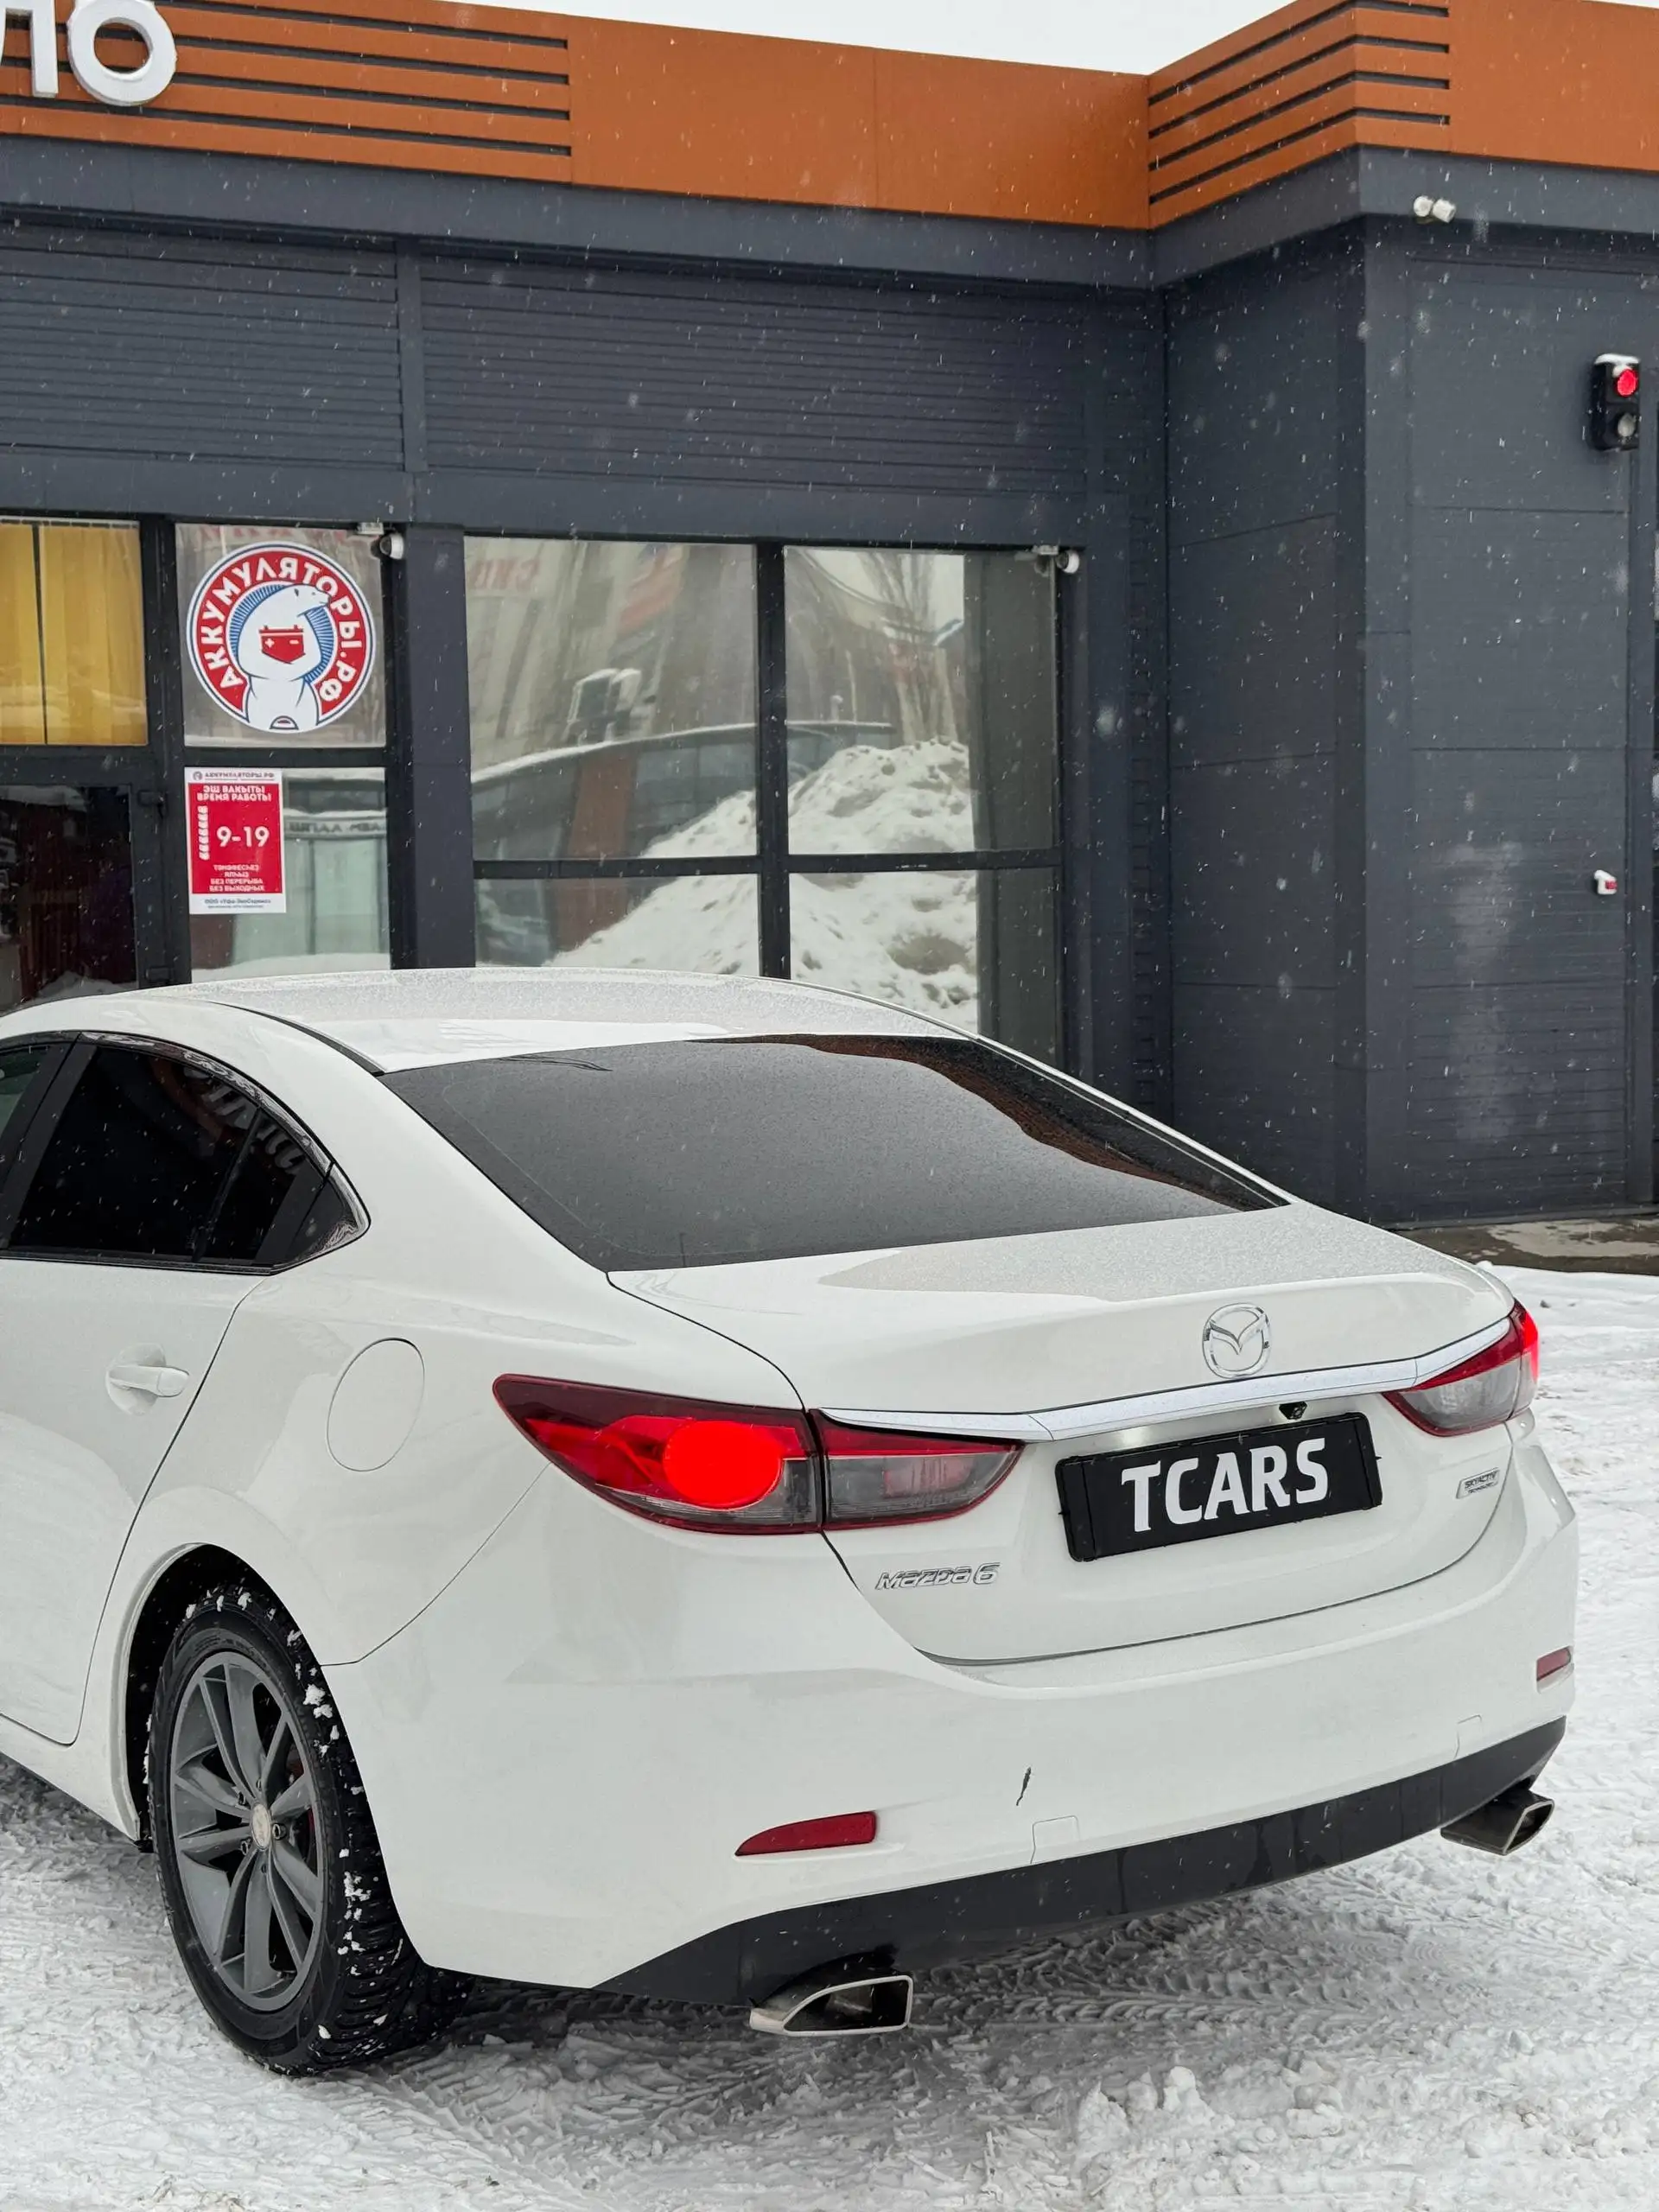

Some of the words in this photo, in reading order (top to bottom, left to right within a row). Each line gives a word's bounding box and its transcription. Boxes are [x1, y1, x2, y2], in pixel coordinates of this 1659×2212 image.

[200, 556, 363, 702] АККУМУЛЯТОРЫ.РФ
[197, 792, 230, 802] ВРЕМЯ
[232, 792, 272, 802] РАБОТЫ
[216, 825, 270, 848] 9-19
[1121, 1437, 1329, 1533] TCARS
